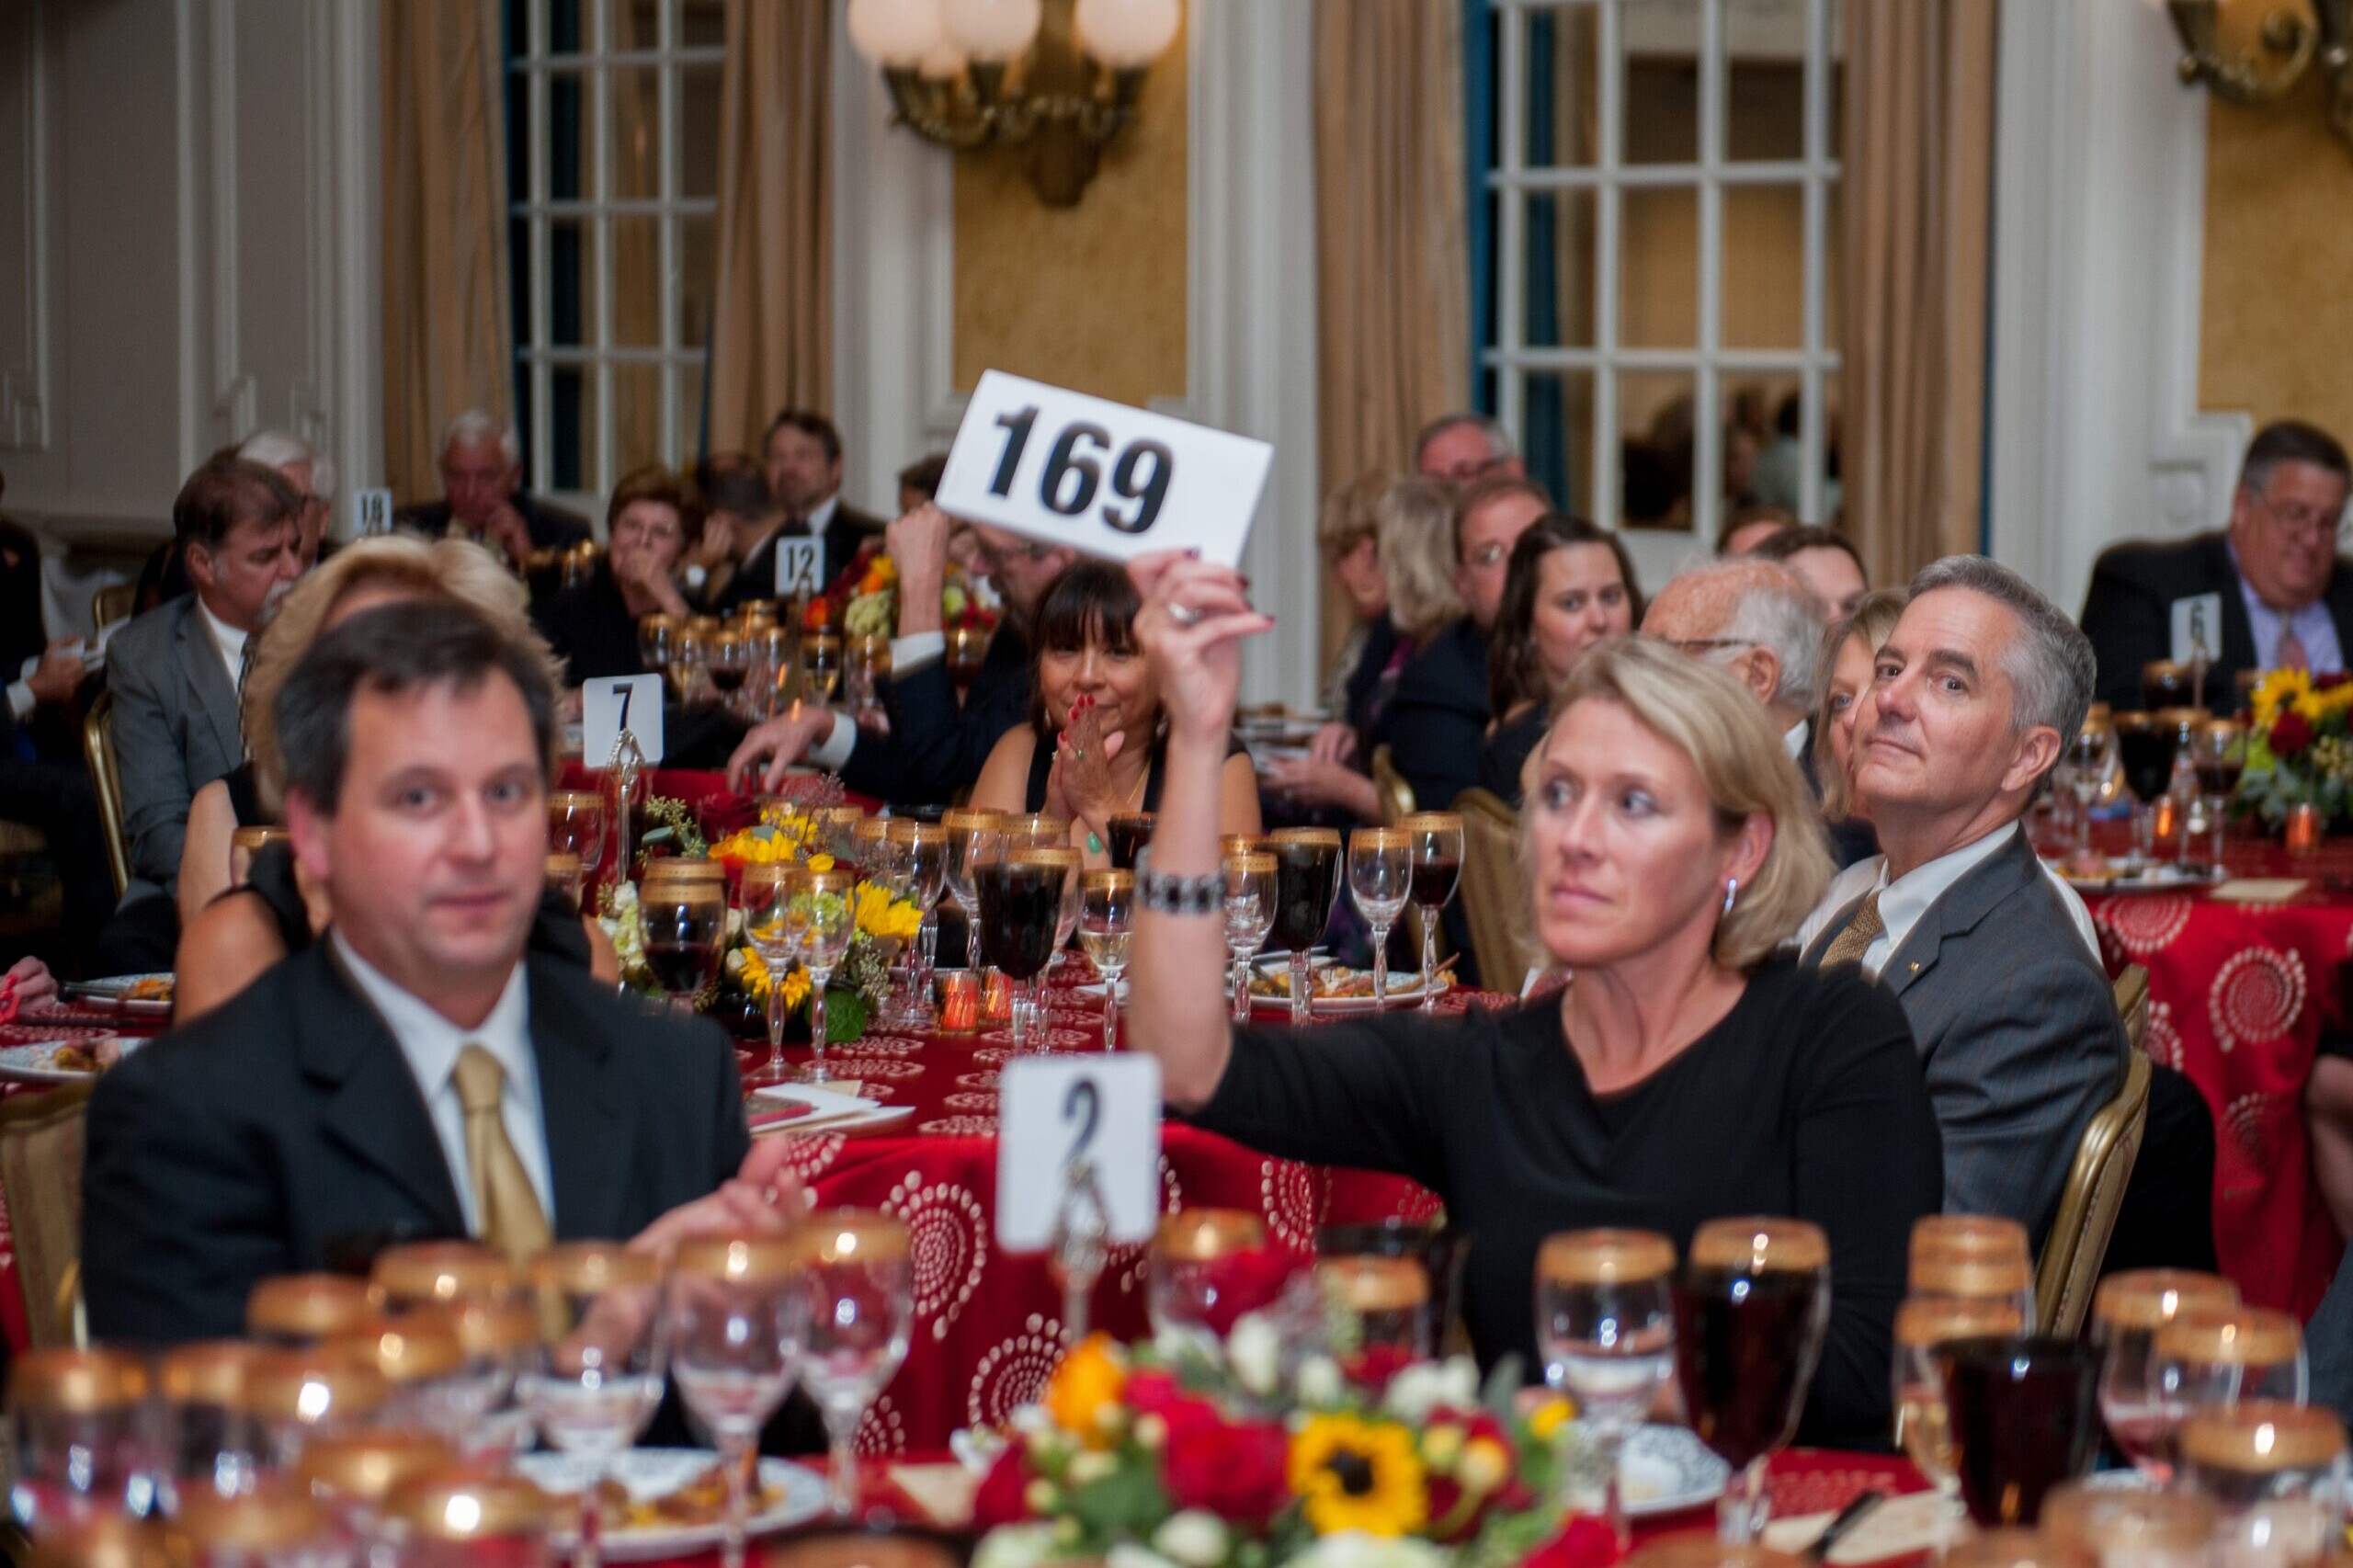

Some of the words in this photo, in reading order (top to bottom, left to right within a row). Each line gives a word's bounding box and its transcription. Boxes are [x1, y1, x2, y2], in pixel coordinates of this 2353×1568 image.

[989, 404, 1174, 534] 169
[788, 544, 814, 582] 12
[612, 682, 633, 732] 7
[1062, 1077, 1100, 1165] 2
